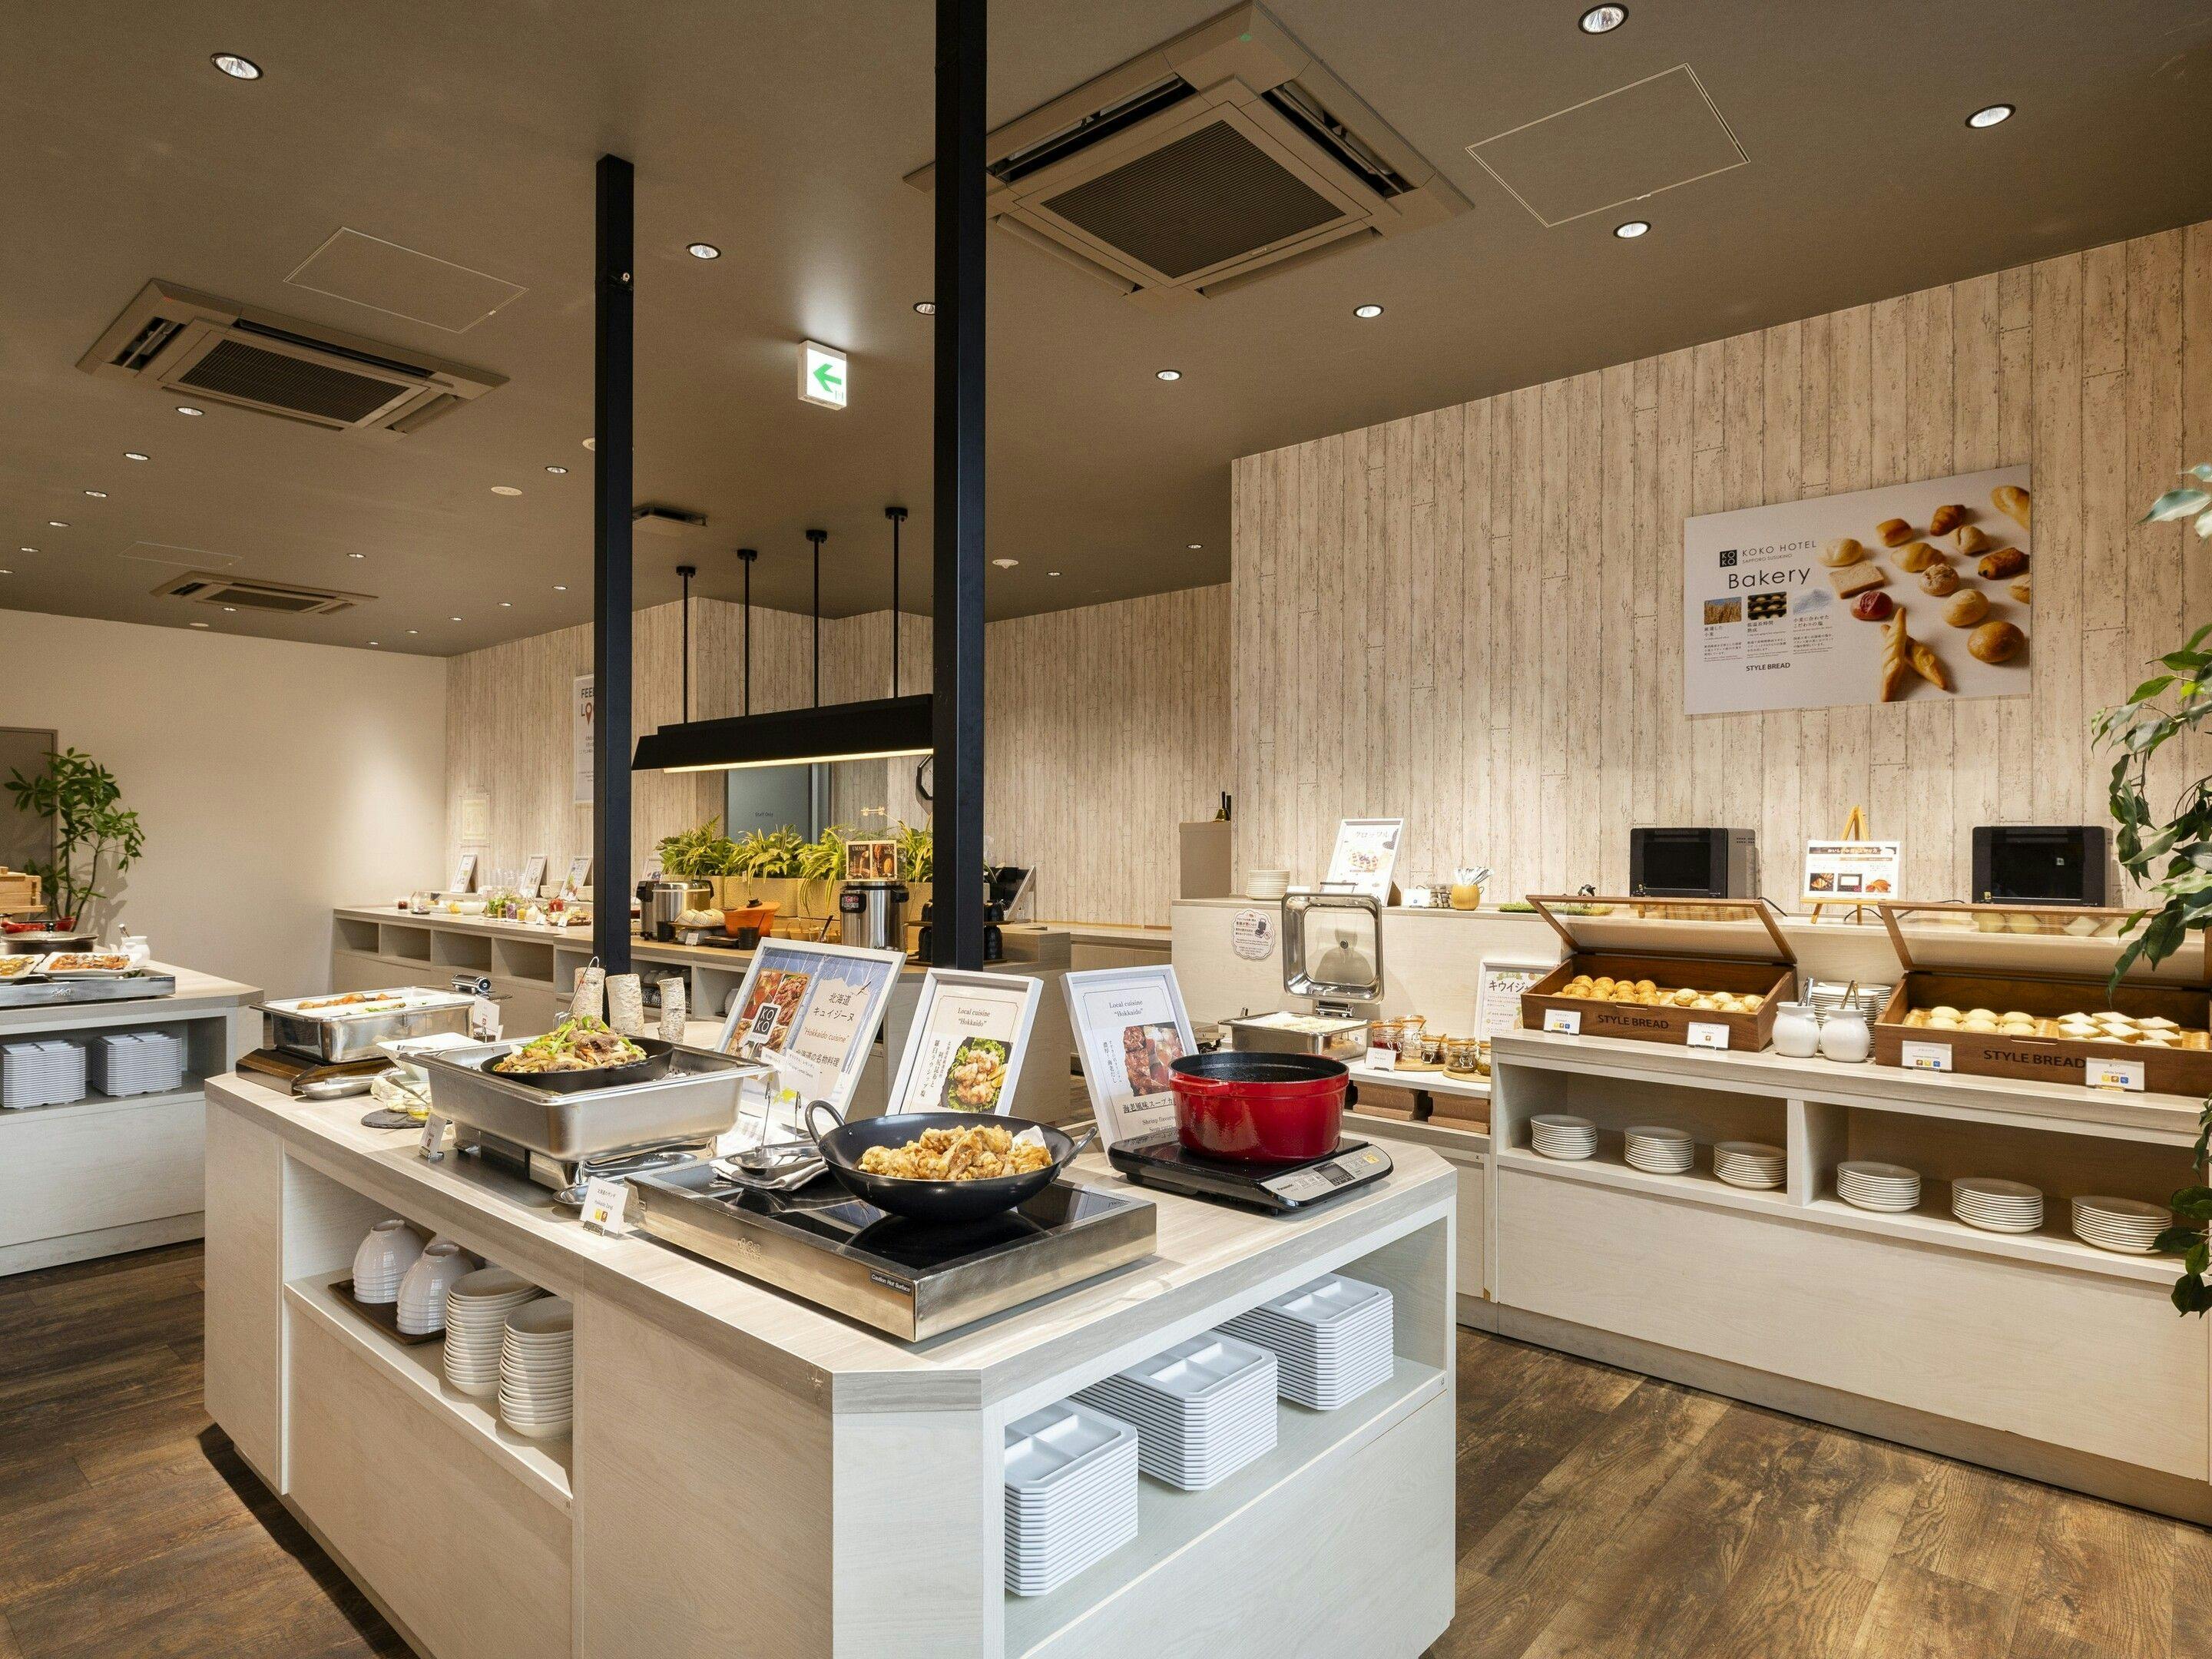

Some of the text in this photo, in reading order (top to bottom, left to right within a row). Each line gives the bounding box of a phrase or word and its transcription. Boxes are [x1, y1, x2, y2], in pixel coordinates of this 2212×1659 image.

[1742, 545, 1774, 557] KOKO
[1780, 540, 1817, 551] HOTEL
[1742, 556, 1767, 565] SAPPORO
[1729, 568, 1811, 590] Bakery
[1746, 662, 1790, 672] STYLE BREAD
[828, 992, 852, 1006] 北海道
[1108, 1000, 1124, 1008] Local
[760, 1008, 774, 1021] KO
[813, 1007, 854, 1022] キュイジーヌ
[958, 1007, 991, 1018] Local cuisine
[756, 1020, 770, 1032] KO
[1598, 1015, 1669, 1029] STYLE BREAD
[1983, 1050, 2086, 1068] STYLE BREAD
[871, 1273, 911, 1293] Caution Hot Surface
